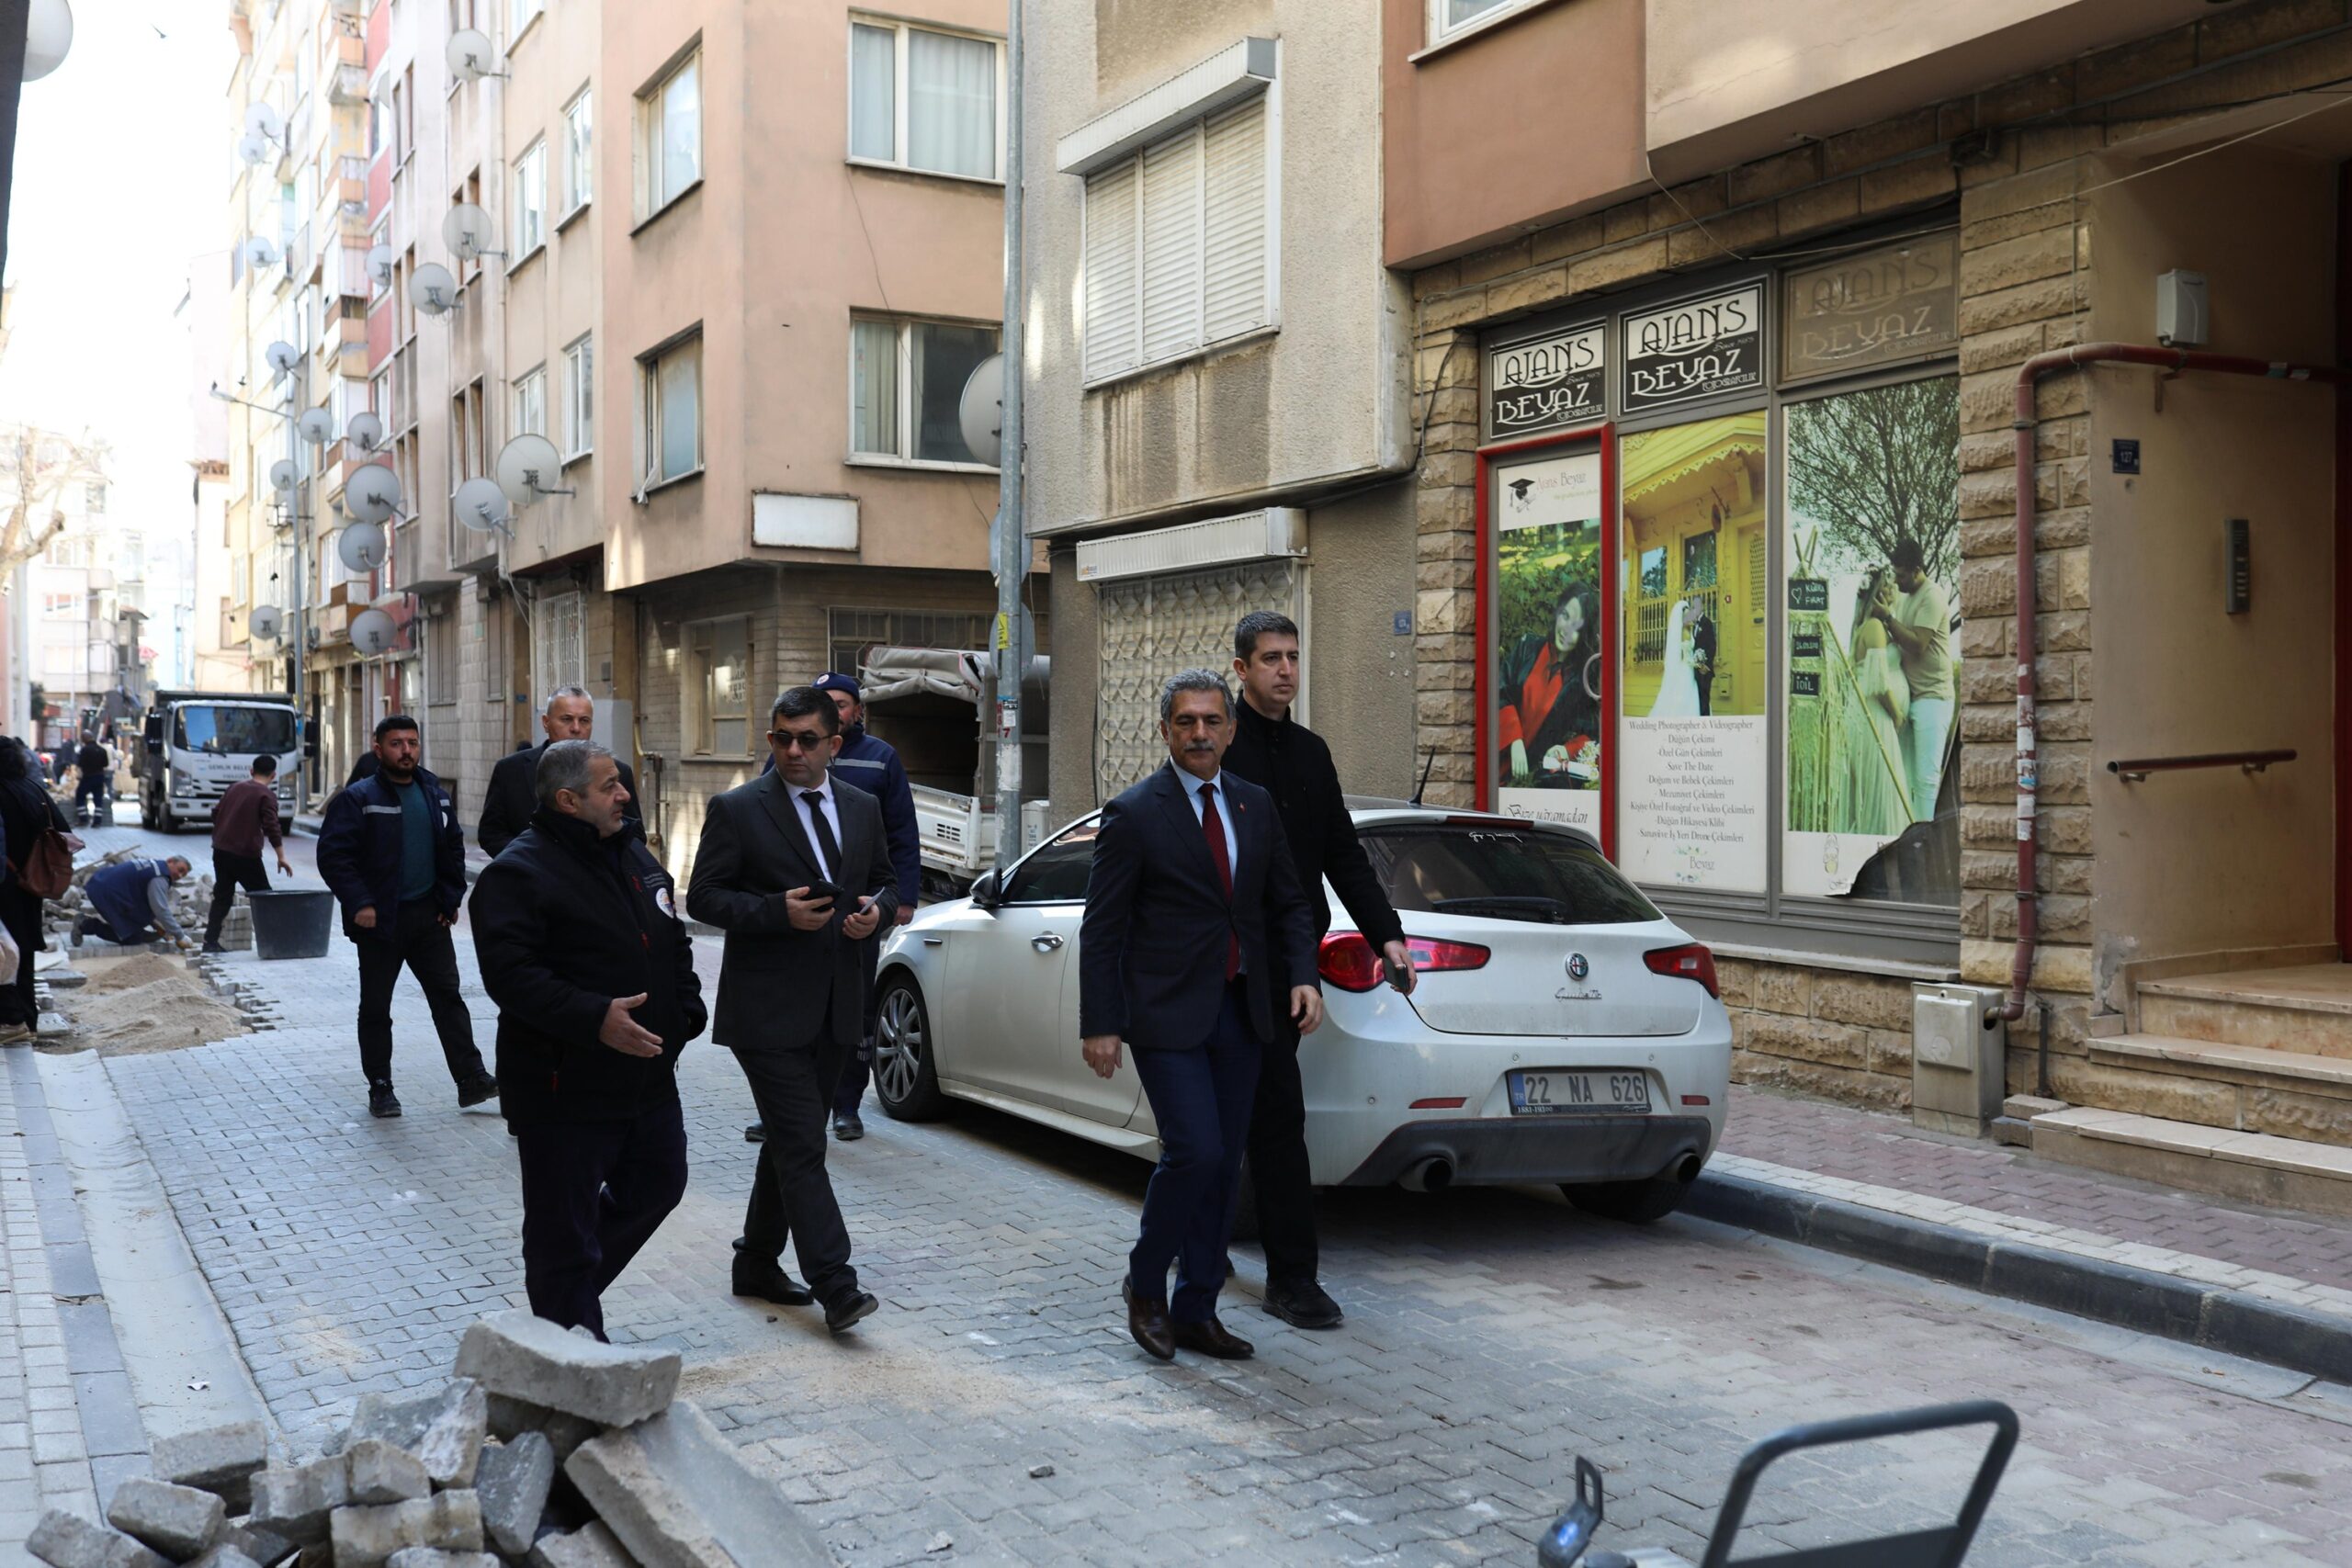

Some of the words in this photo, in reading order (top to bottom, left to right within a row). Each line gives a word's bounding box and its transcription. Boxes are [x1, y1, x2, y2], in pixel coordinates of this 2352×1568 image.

[1810, 251, 1939, 311] AJANS
[1638, 299, 1747, 354] AJANS
[1799, 306, 1932, 359] BEYAZ
[1502, 337, 1594, 386] AJANS
[1631, 348, 1742, 397] BEYAZ
[1496, 382, 1590, 424] BEYAZ
[1629, 721, 1657, 732] Wedding
[1658, 721, 1701, 732] Photographer
[1709, 719, 1753, 732] Videographer
[1691, 748, 1723, 759] Çekimleri
[1684, 761, 1697, 771] The
[1698, 761, 1713, 771] Date
[1681, 775, 1701, 784] Bebek
[1702, 776, 1735, 786] Çekimleri
[1693, 790, 1725, 800] Çekimleri
[1702, 804, 1721, 813] Video
[1722, 805, 1755, 815] Çekimleri
[1712, 832, 1744, 842] Çekimleri
[1514, 1093, 1525, 1101] TR
[1525, 1077, 1552, 1103] 22
[1567, 1076, 1594, 1103] NA
[1610, 1076, 1645, 1102] 626
